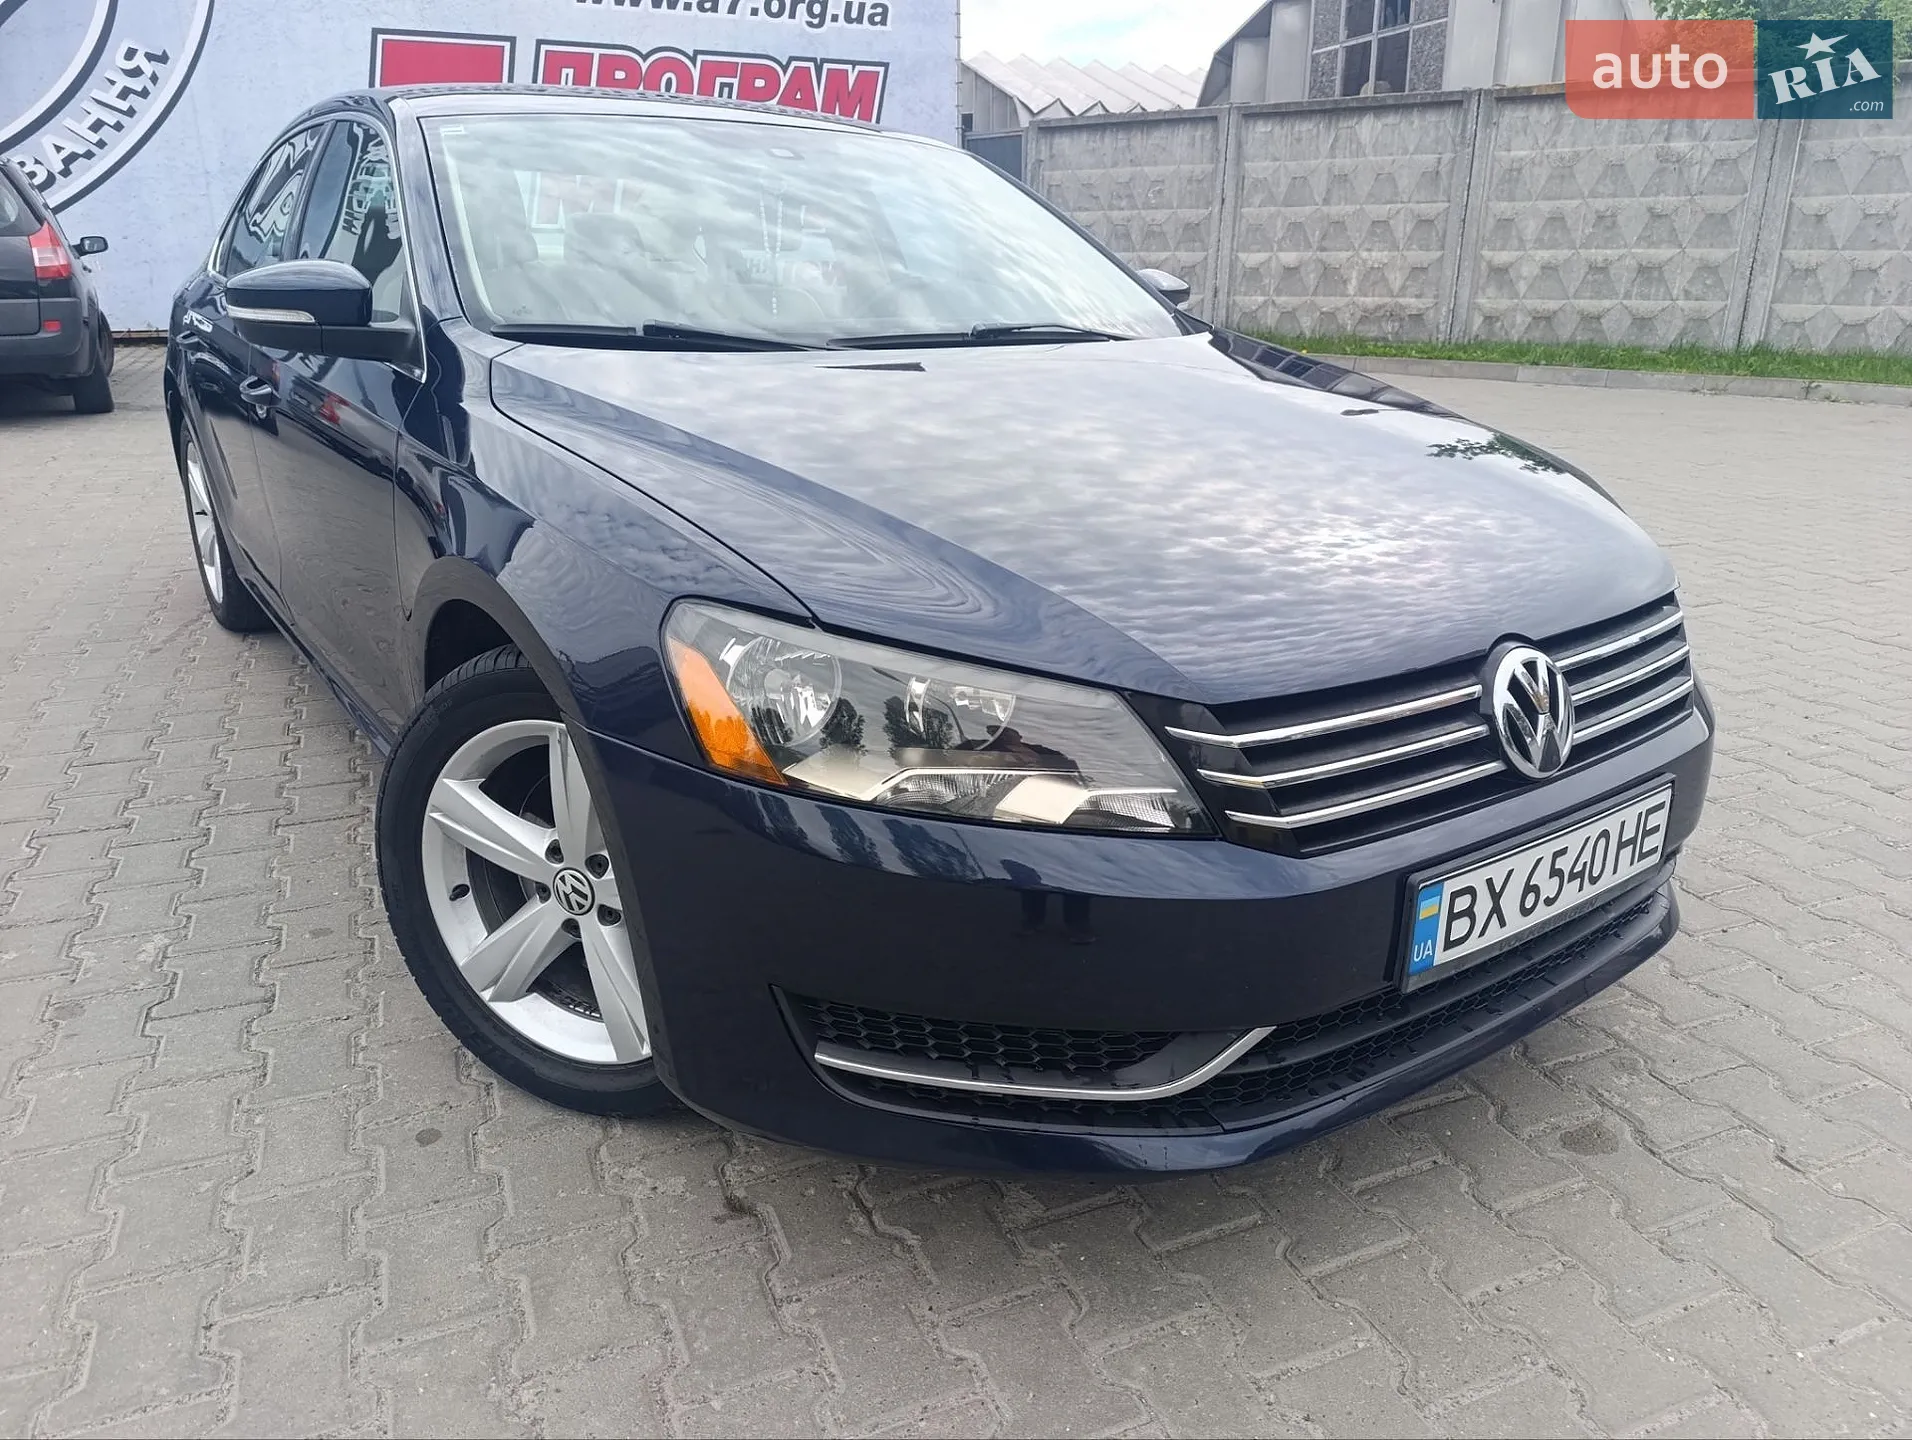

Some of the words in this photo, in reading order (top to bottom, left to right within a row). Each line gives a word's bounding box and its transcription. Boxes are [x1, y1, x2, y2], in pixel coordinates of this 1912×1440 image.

[575, 0, 889, 29] .a.org.ua
[538, 45, 886, 124] ПРОГРАМ
[1443, 868, 1515, 953] BX
[1519, 828, 1611, 918] 6540
[1612, 801, 1666, 876] HE
[1413, 944, 1434, 963] UA
